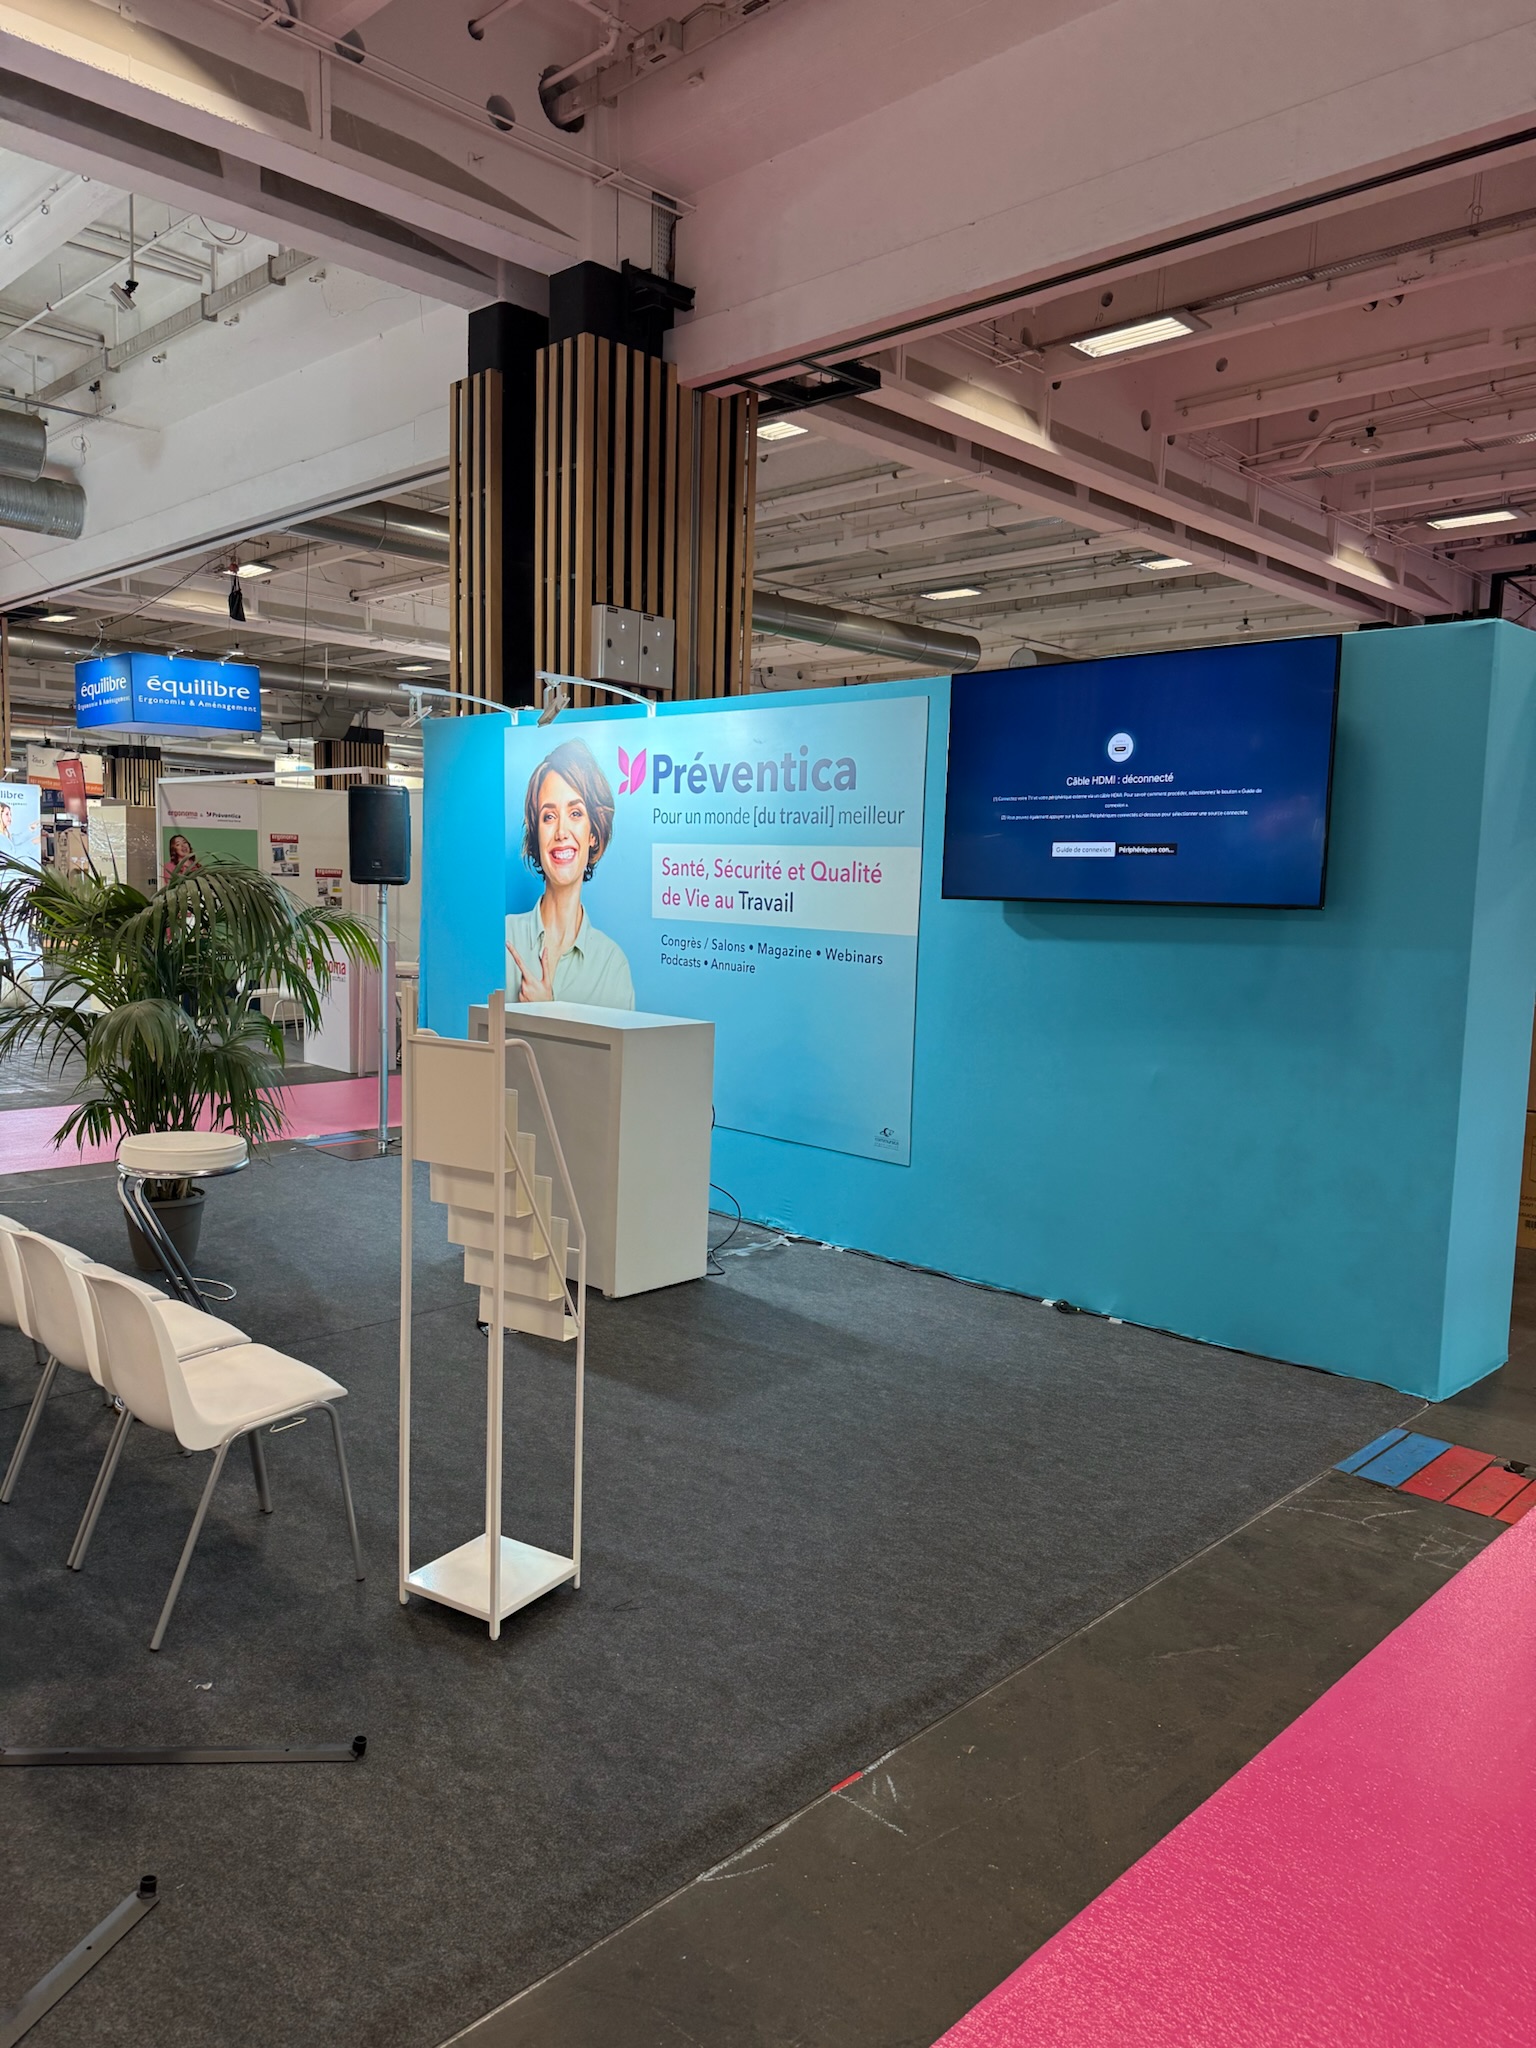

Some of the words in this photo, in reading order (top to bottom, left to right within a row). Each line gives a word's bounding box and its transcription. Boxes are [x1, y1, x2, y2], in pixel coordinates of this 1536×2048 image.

[81, 675, 127, 700] équilibre
[146, 675, 250, 699] équilibre
[138, 695, 186, 706] Ergonomie
[189, 699, 196, 707] &
[198, 700, 257, 713] Aménagement
[653, 745, 857, 794] Préventica
[1066, 776, 1090, 786] Câble
[1091, 775, 1116, 785] HDMI
[1122, 772, 1174, 784] déconnecté
[653, 807, 682, 824] Pour
[685, 812, 701, 824] un
[704, 806, 750, 824] monde
[754, 805, 776, 828] [du
[780, 804, 834, 828] travail]
[838, 805, 905, 825] meilleur
[1118, 846, 1158, 854] Périphériques
[662, 857, 709, 880] Santé,
[714, 858, 782, 880] Sécurité
[788, 863, 805, 881] et
[811, 860, 882, 884] Qualité
[662, 886, 681, 906] de
[685, 888, 710, 908] Vie
[715, 894, 734, 909] au
[738, 890, 793, 912] Travail
[661, 934, 702, 951] Congrès
[712, 938, 746, 953] Salons
[757, 942, 812, 959] Magazine
[825, 947, 883, 965] Webinars
[661, 953, 701, 969] Podcasts
[710, 958, 756, 974] Annuaire
